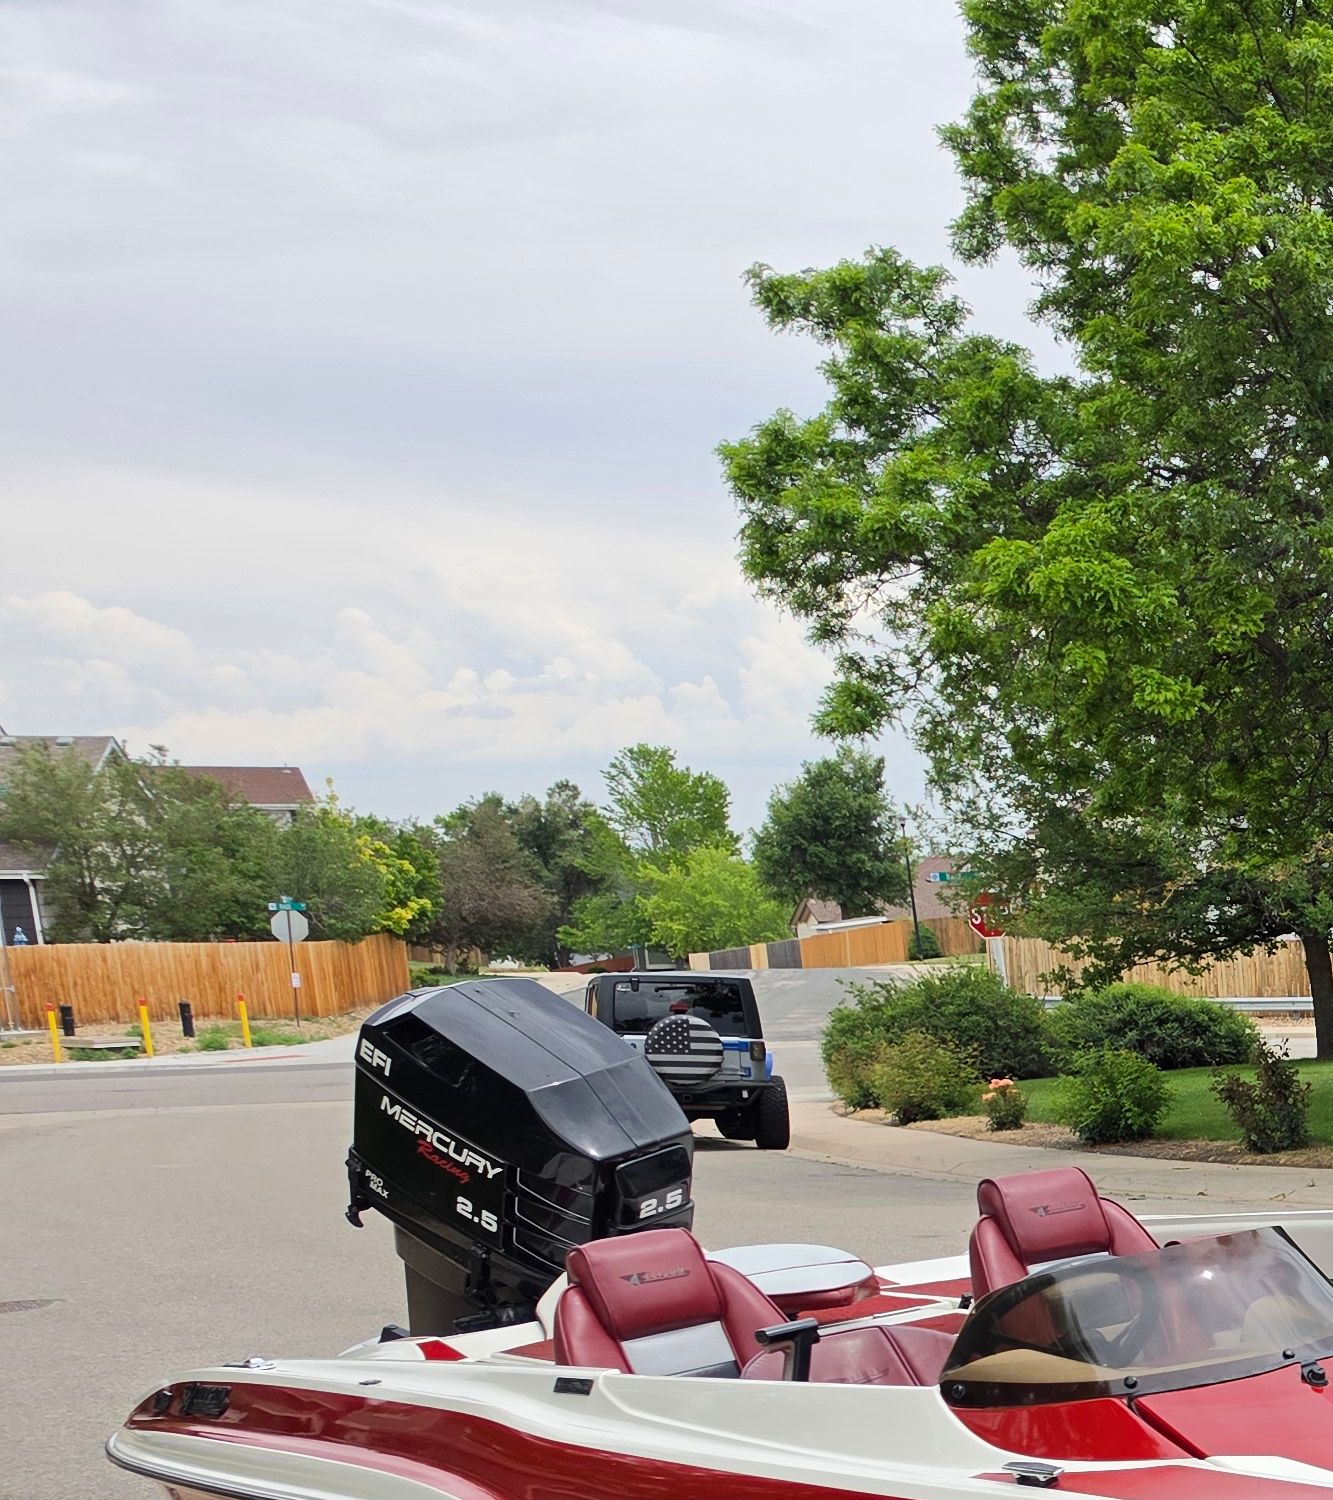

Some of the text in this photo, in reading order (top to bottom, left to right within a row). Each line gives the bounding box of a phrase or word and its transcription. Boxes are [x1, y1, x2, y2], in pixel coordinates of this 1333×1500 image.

[360, 1038, 393, 1077] EFI
[380, 1096, 504, 1179] MERCURY
[365, 1169, 384, 1187] PRO
[417, 1139, 470, 1184] Racing
[369, 1180, 389, 1199] MAX
[639, 1188, 684, 1219] 2.5
[456, 1195, 498, 1233] 2.5
